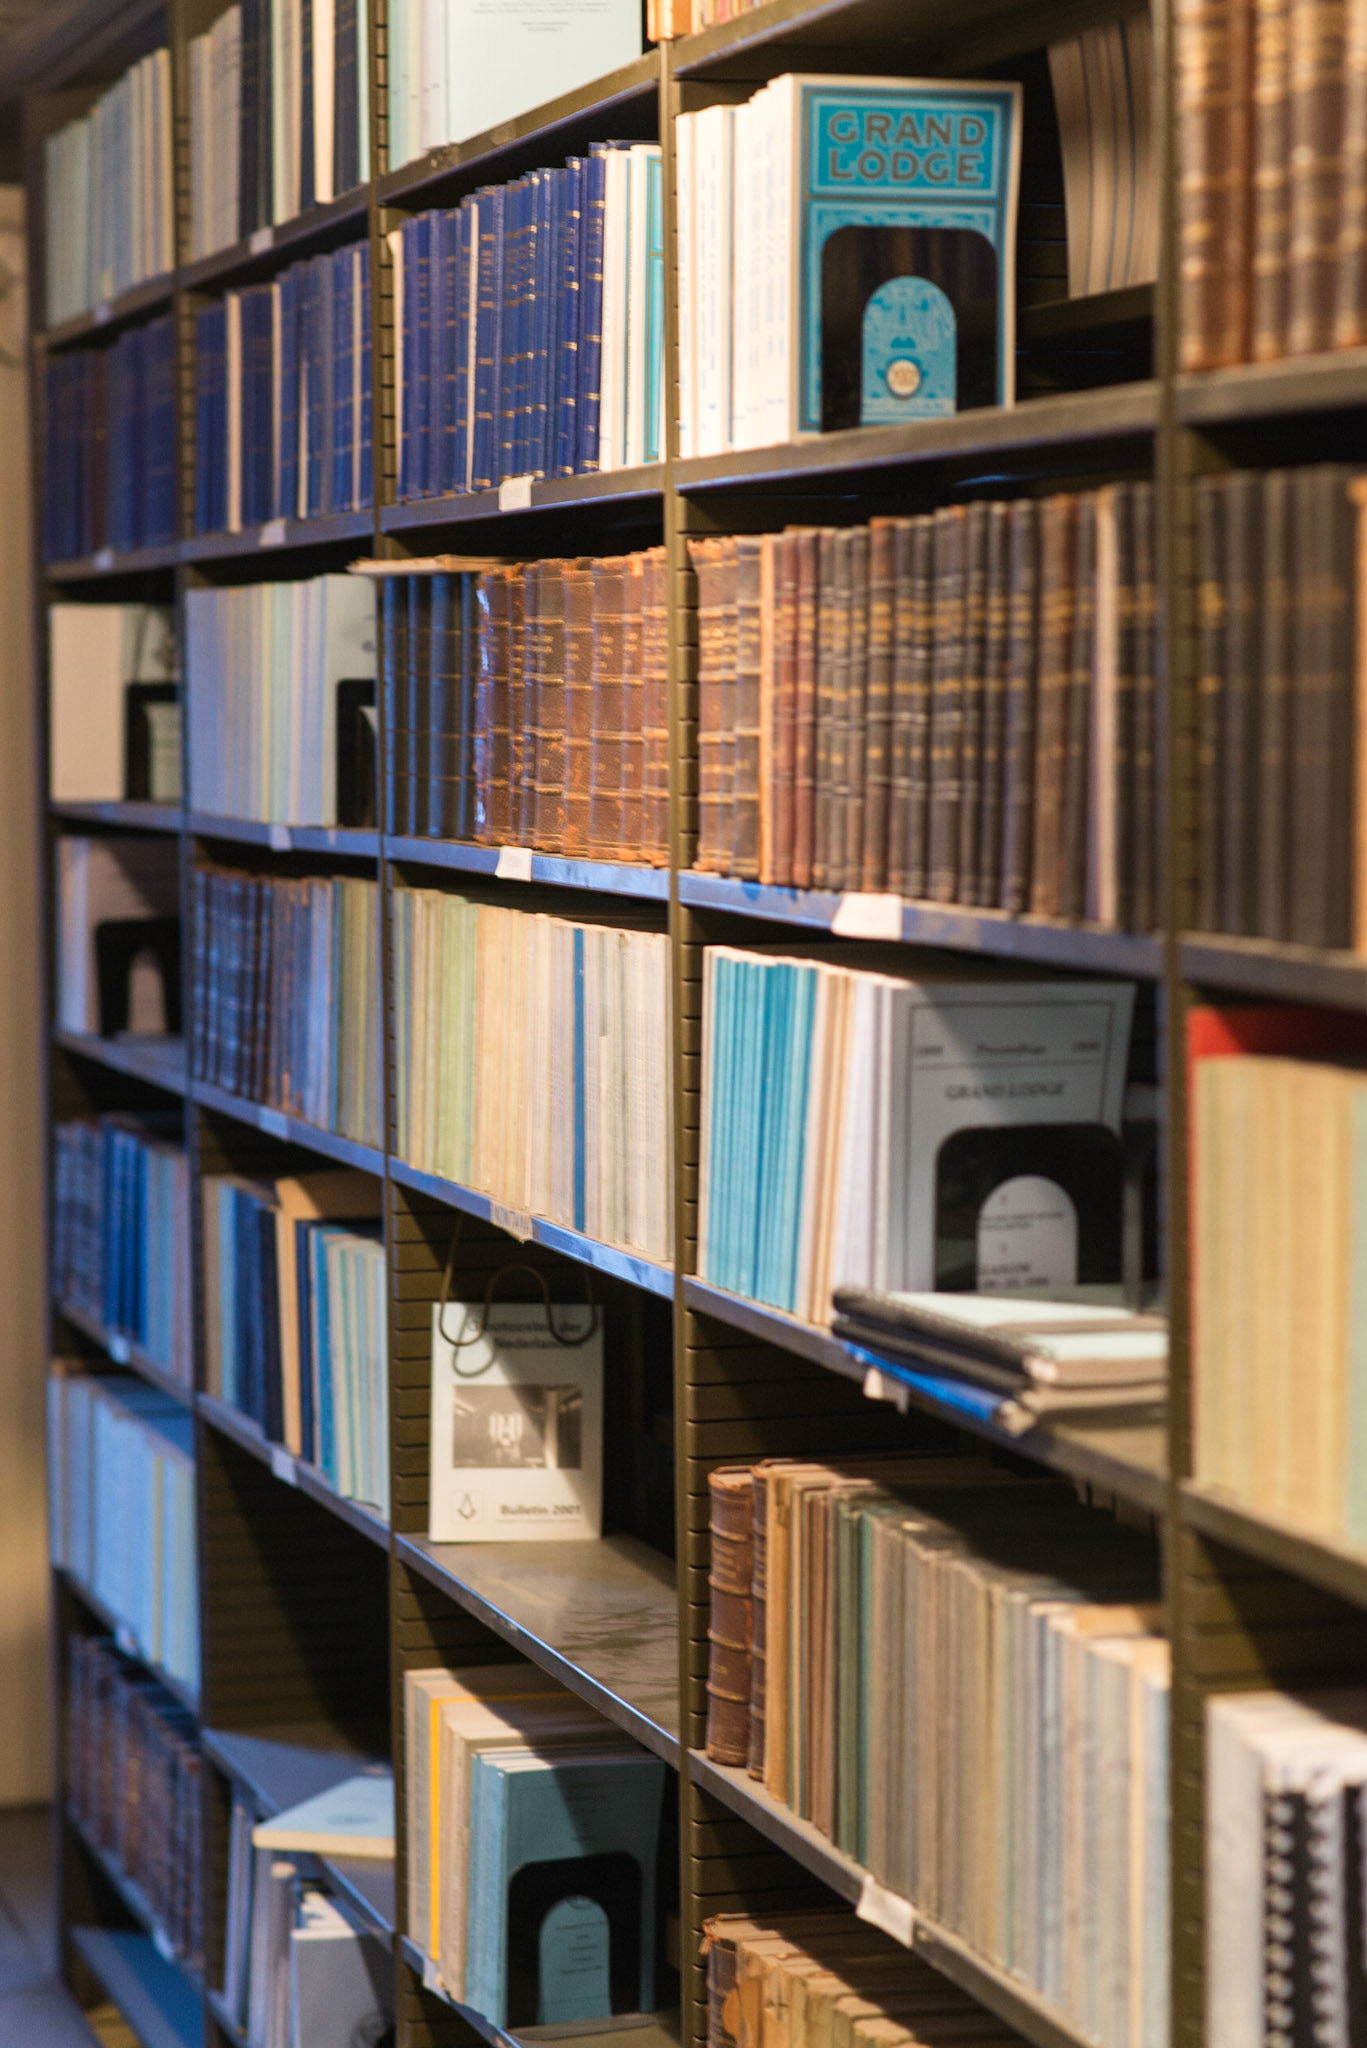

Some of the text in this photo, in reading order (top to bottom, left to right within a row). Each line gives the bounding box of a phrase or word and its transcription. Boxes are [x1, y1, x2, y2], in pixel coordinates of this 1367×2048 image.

[828, 111, 987, 147] GRAND
[828, 148, 984, 183] LODGE
[944, 1080, 1065, 1101] GRAND LODGE
[500, 1504, 548, 1516] Bulletin
